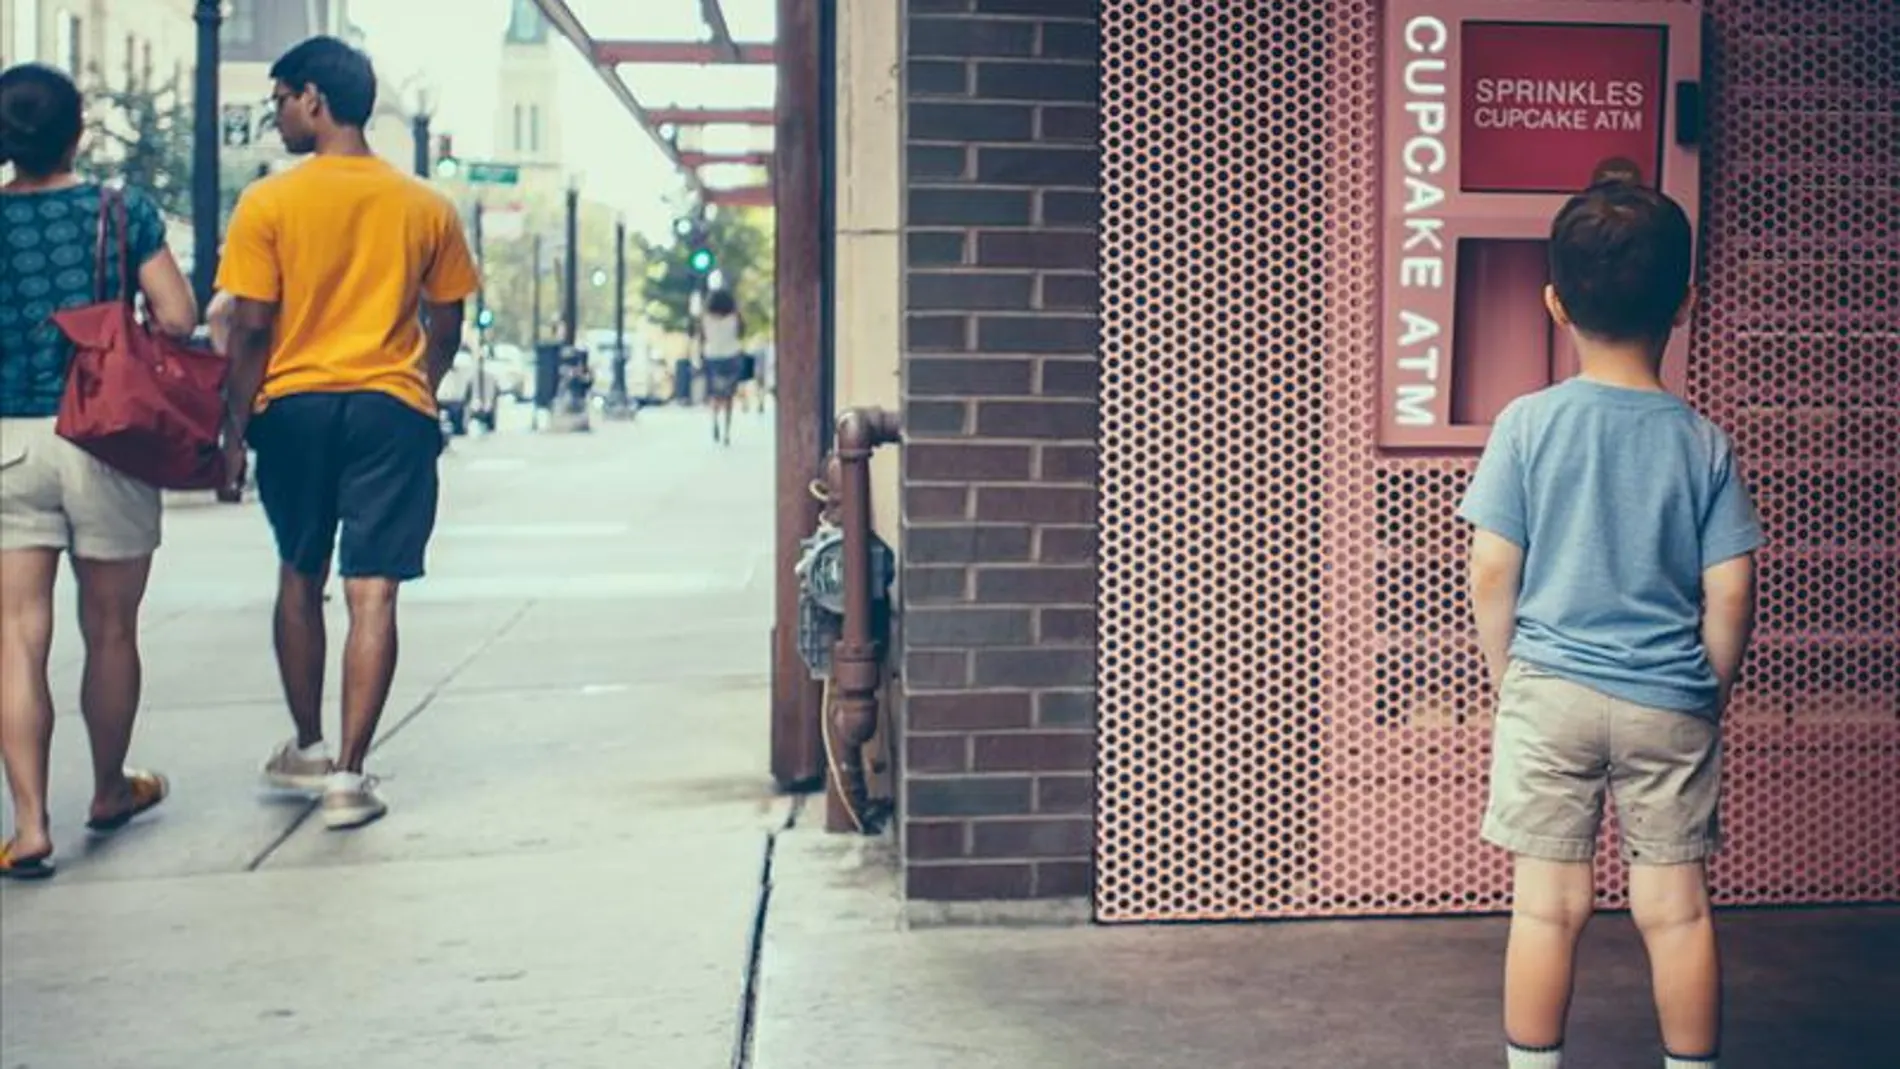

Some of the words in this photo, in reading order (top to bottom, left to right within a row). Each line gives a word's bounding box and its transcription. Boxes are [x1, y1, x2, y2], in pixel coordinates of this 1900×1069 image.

[1474, 107, 1588, 130] CUPCAKE
[1594, 110, 1642, 131] ATM
[1475, 79, 1644, 106] SPRINKLES
[1401, 16, 1447, 288] CUPCAKE
[1395, 310, 1440, 427] ATM
